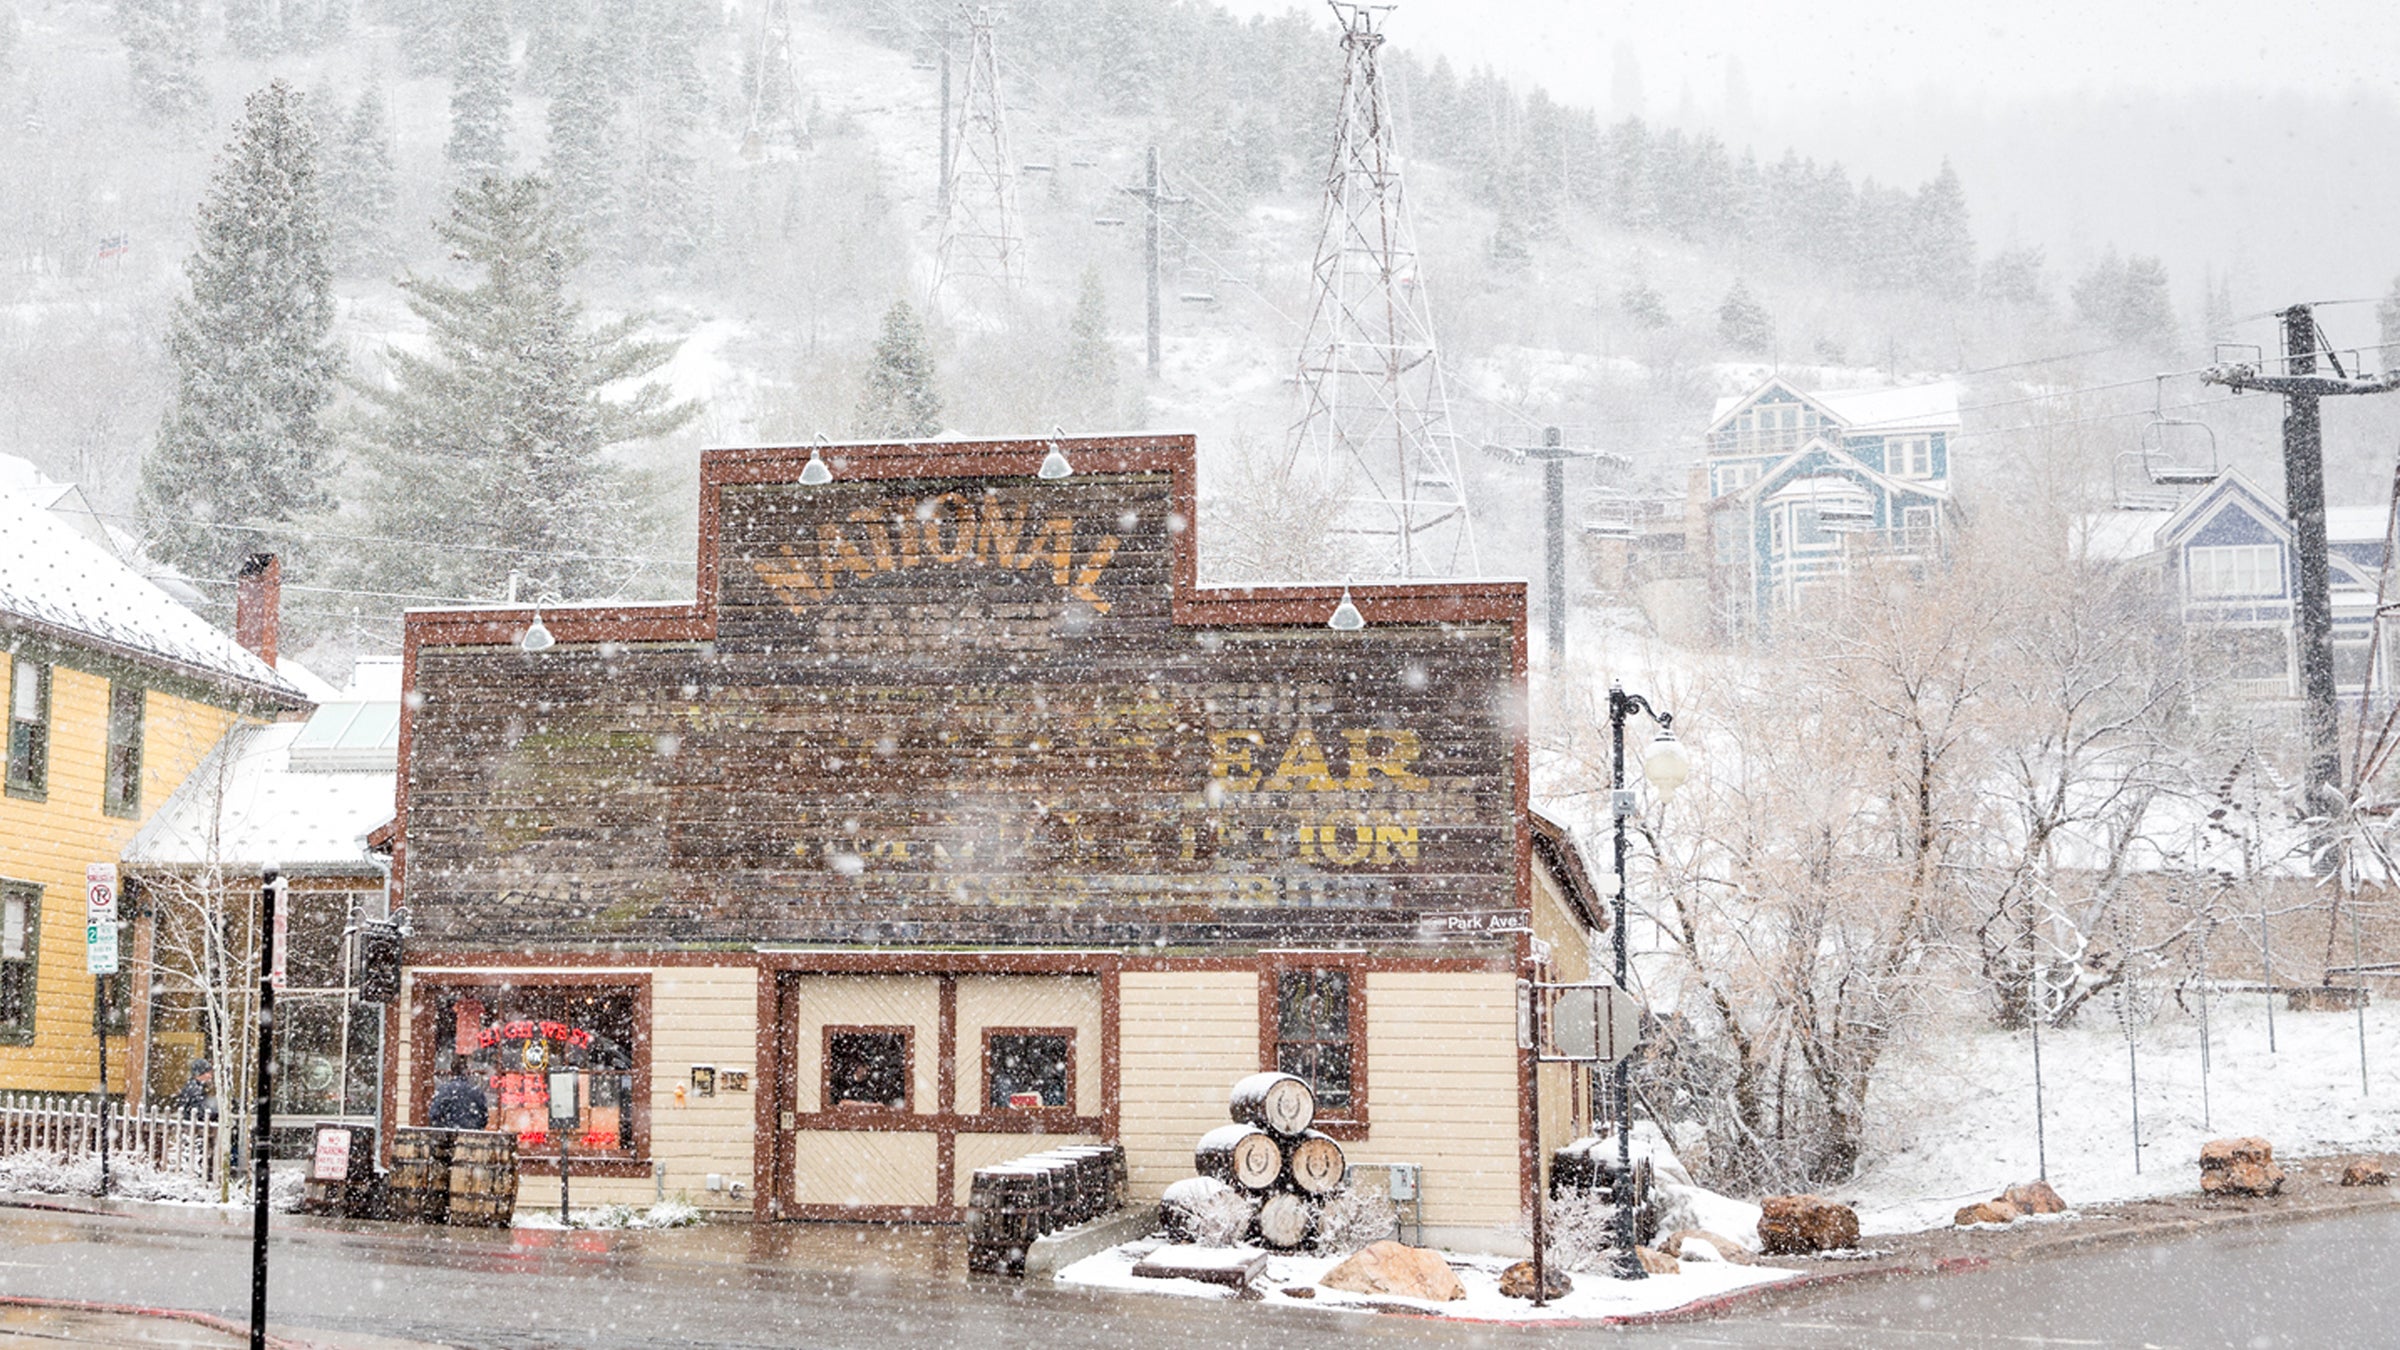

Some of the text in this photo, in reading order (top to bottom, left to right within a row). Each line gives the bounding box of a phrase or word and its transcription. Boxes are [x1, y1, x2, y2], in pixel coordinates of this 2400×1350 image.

[755, 492, 1121, 615] NATIONAL
[1448, 915, 1521, 929] Park Ave.
[477, 1021, 590, 1049] HIGH WEST
